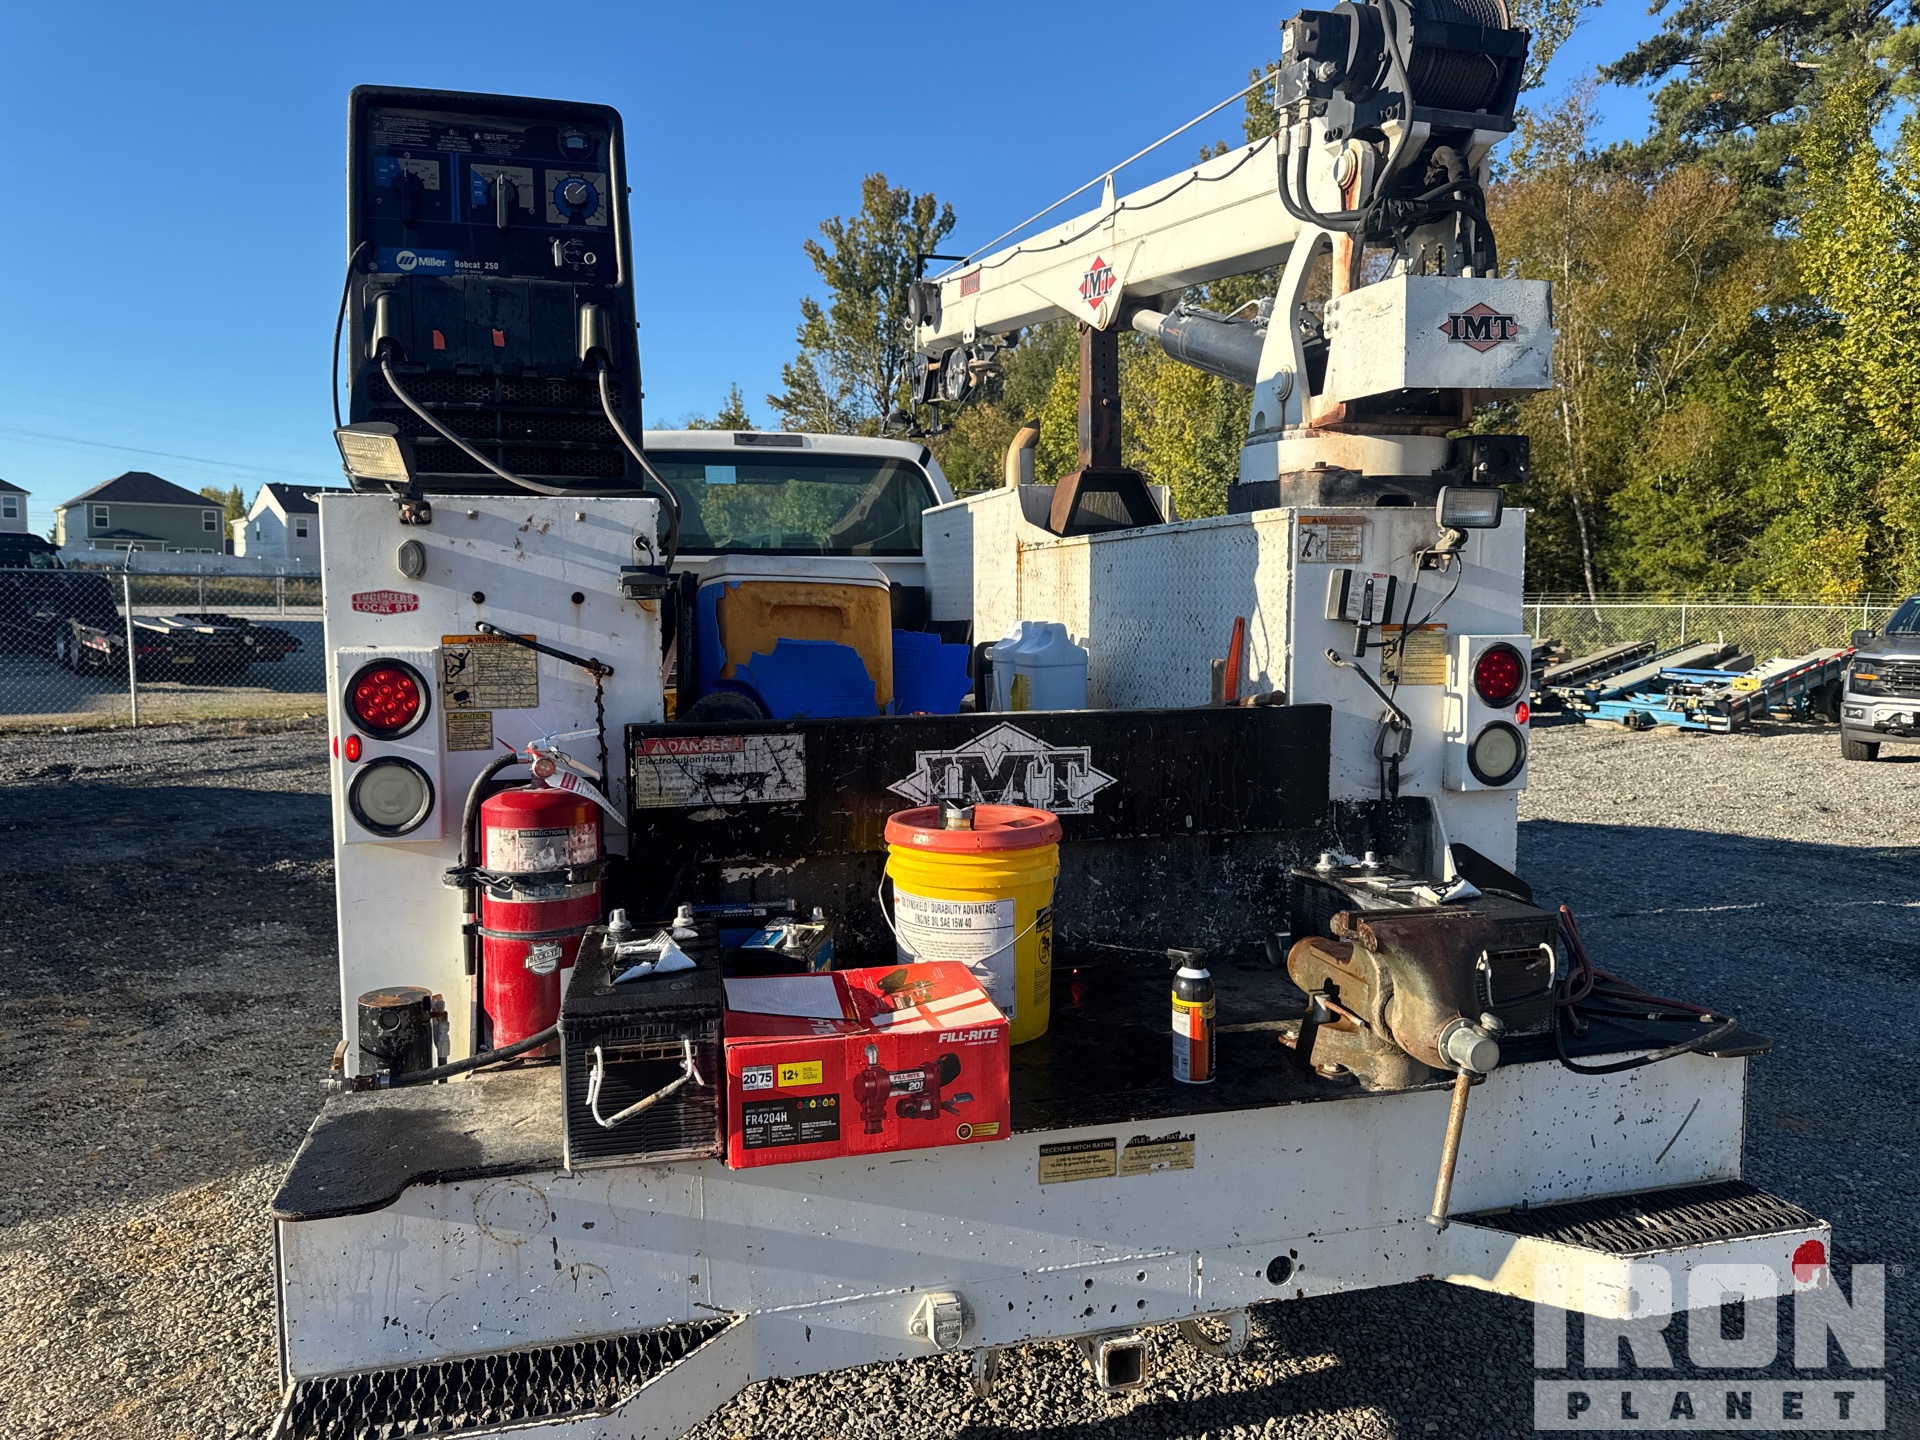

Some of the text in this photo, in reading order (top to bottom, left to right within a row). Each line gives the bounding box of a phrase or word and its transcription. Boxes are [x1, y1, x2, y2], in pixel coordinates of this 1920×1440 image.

[418, 257, 446, 267] Miller
[454, 260, 499, 270] Bobcat 250
[1082, 266, 1112, 300] IMT
[1449, 315, 1513, 340] IMT
[355, 592, 415, 602] ENGINEERS
[356, 603, 415, 613] LOCAL 917
[668, 740, 731, 753] DANGER
[703, 754, 735, 764] Hazard
[917, 746, 1091, 814] IMT
[520, 829, 567, 837] INSTRUCTIONS
[931, 903, 961, 915] DURABILITY
[963, 903, 997, 915] ADVANTAGE
[914, 913, 931, 926] ENGINE
[931, 916, 939, 927] OIL
[940, 917, 951, 927] SAE
[529, 949, 560, 963] BUCKEYE
[938, 1028, 999, 1043] FILL-RITE
[743, 1073, 757, 1084] 20
[759, 1072, 772, 1083] 75
[745, 1111, 788, 1126] FR4204H
[1040, 1141, 1115, 1154] RECEIVER HITCH RATING
